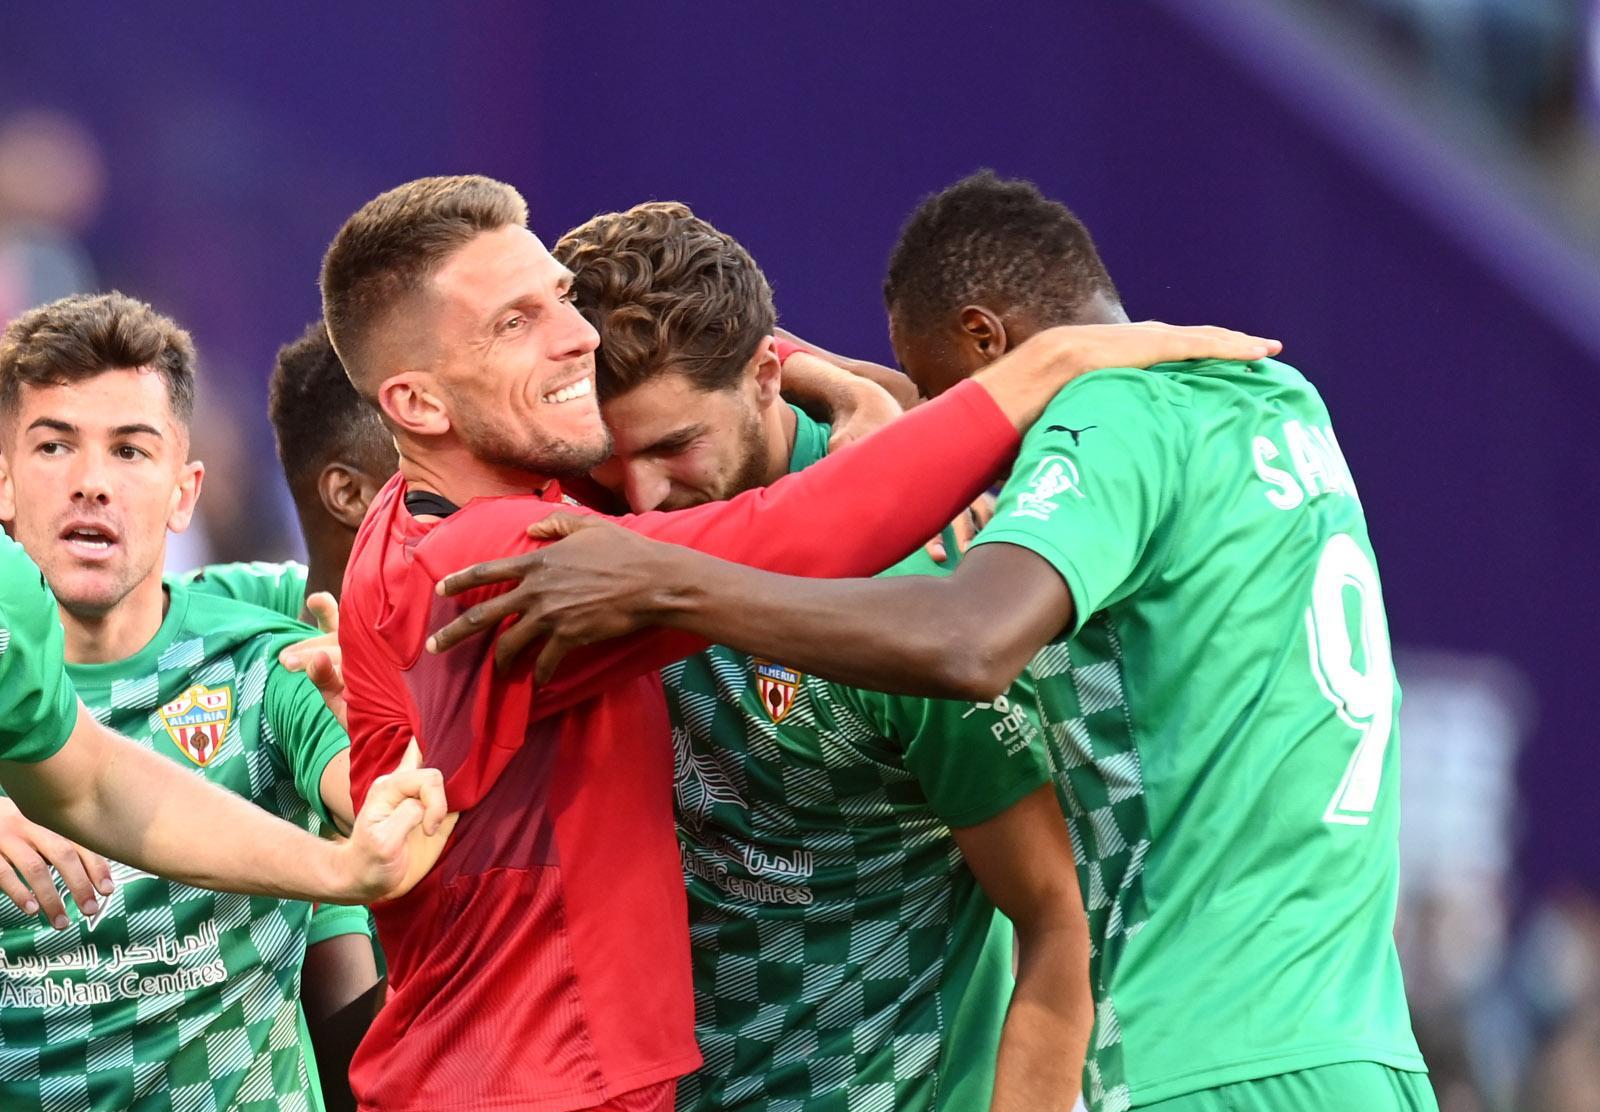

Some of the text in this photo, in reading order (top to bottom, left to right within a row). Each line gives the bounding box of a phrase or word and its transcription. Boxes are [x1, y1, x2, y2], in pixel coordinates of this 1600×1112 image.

[758, 665, 796, 683] ALMERIA
[1304, 533, 1394, 826] 9
[169, 709, 225, 727] ALMERIA
[714, 863, 814, 905] Centres
[0, 957, 229, 1009] Arabian Centres
